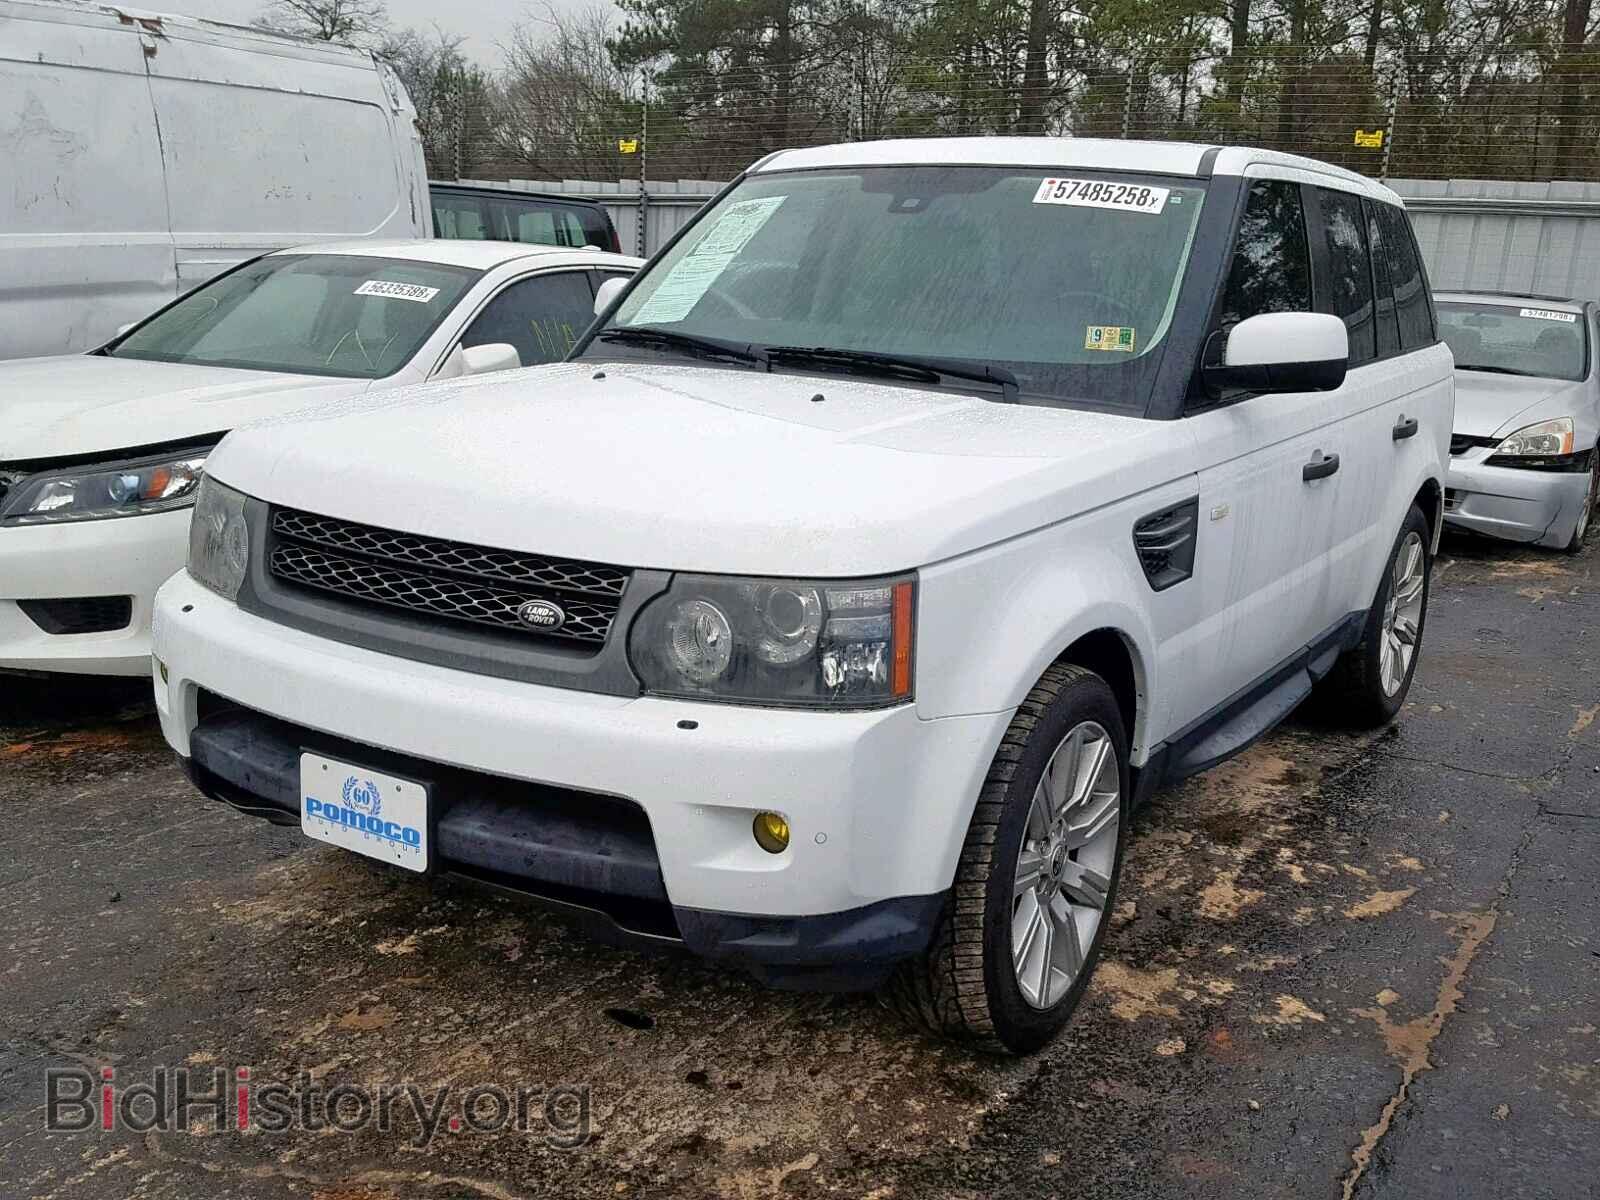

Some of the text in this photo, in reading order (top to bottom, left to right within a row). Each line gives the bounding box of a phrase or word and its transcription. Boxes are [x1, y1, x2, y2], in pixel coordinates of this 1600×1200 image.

[527, 606, 550, 616] LAND
[528, 614, 555, 625] ROVER
[353, 788, 370, 805] 60
